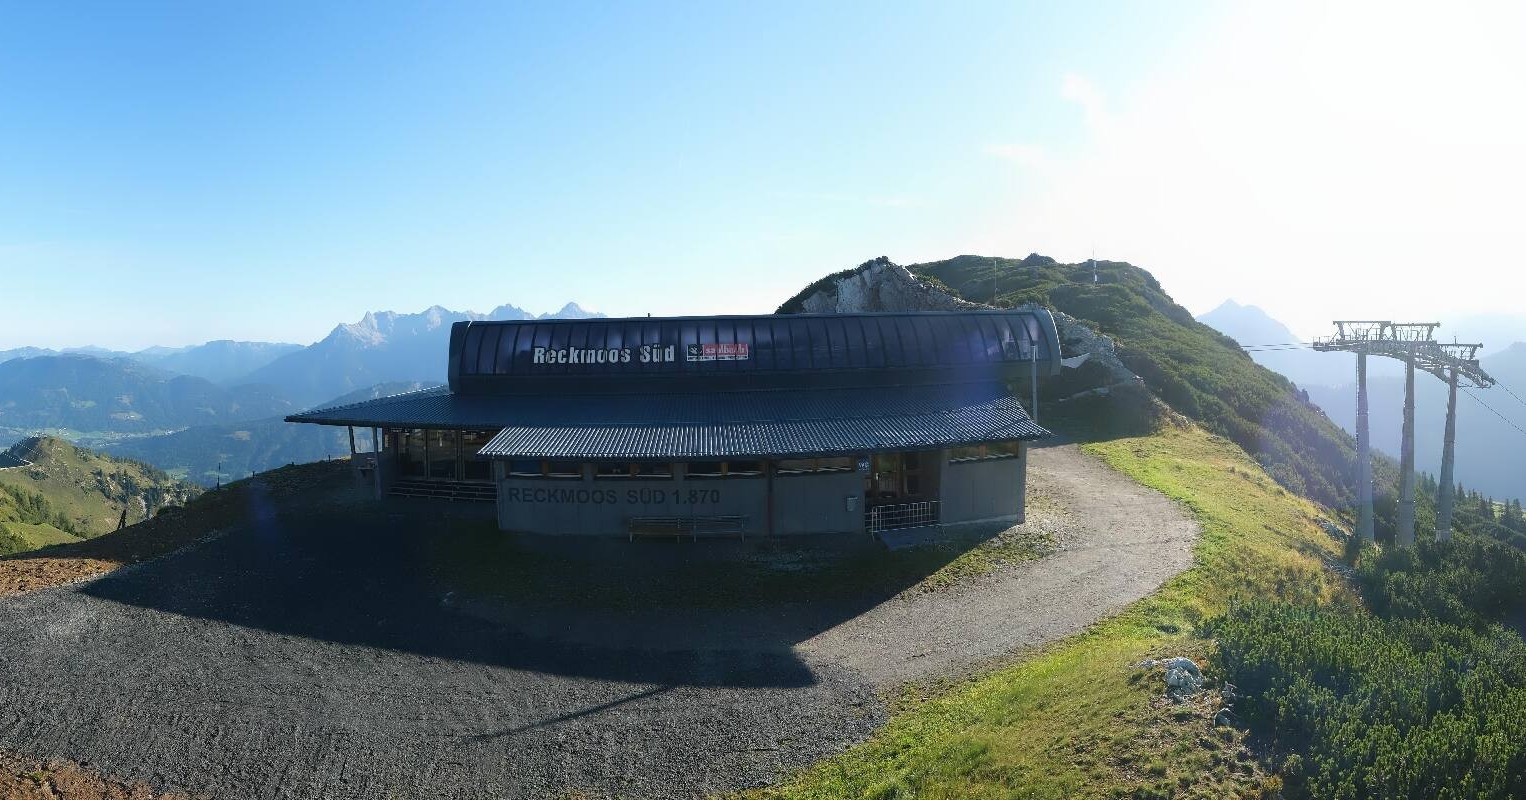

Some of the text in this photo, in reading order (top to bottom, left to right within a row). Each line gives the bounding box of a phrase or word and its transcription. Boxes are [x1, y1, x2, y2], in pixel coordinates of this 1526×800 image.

[533, 344, 676, 364] Reckmoos Süd
[508, 487, 721, 505] RECKMOOS SÜD 1.870
